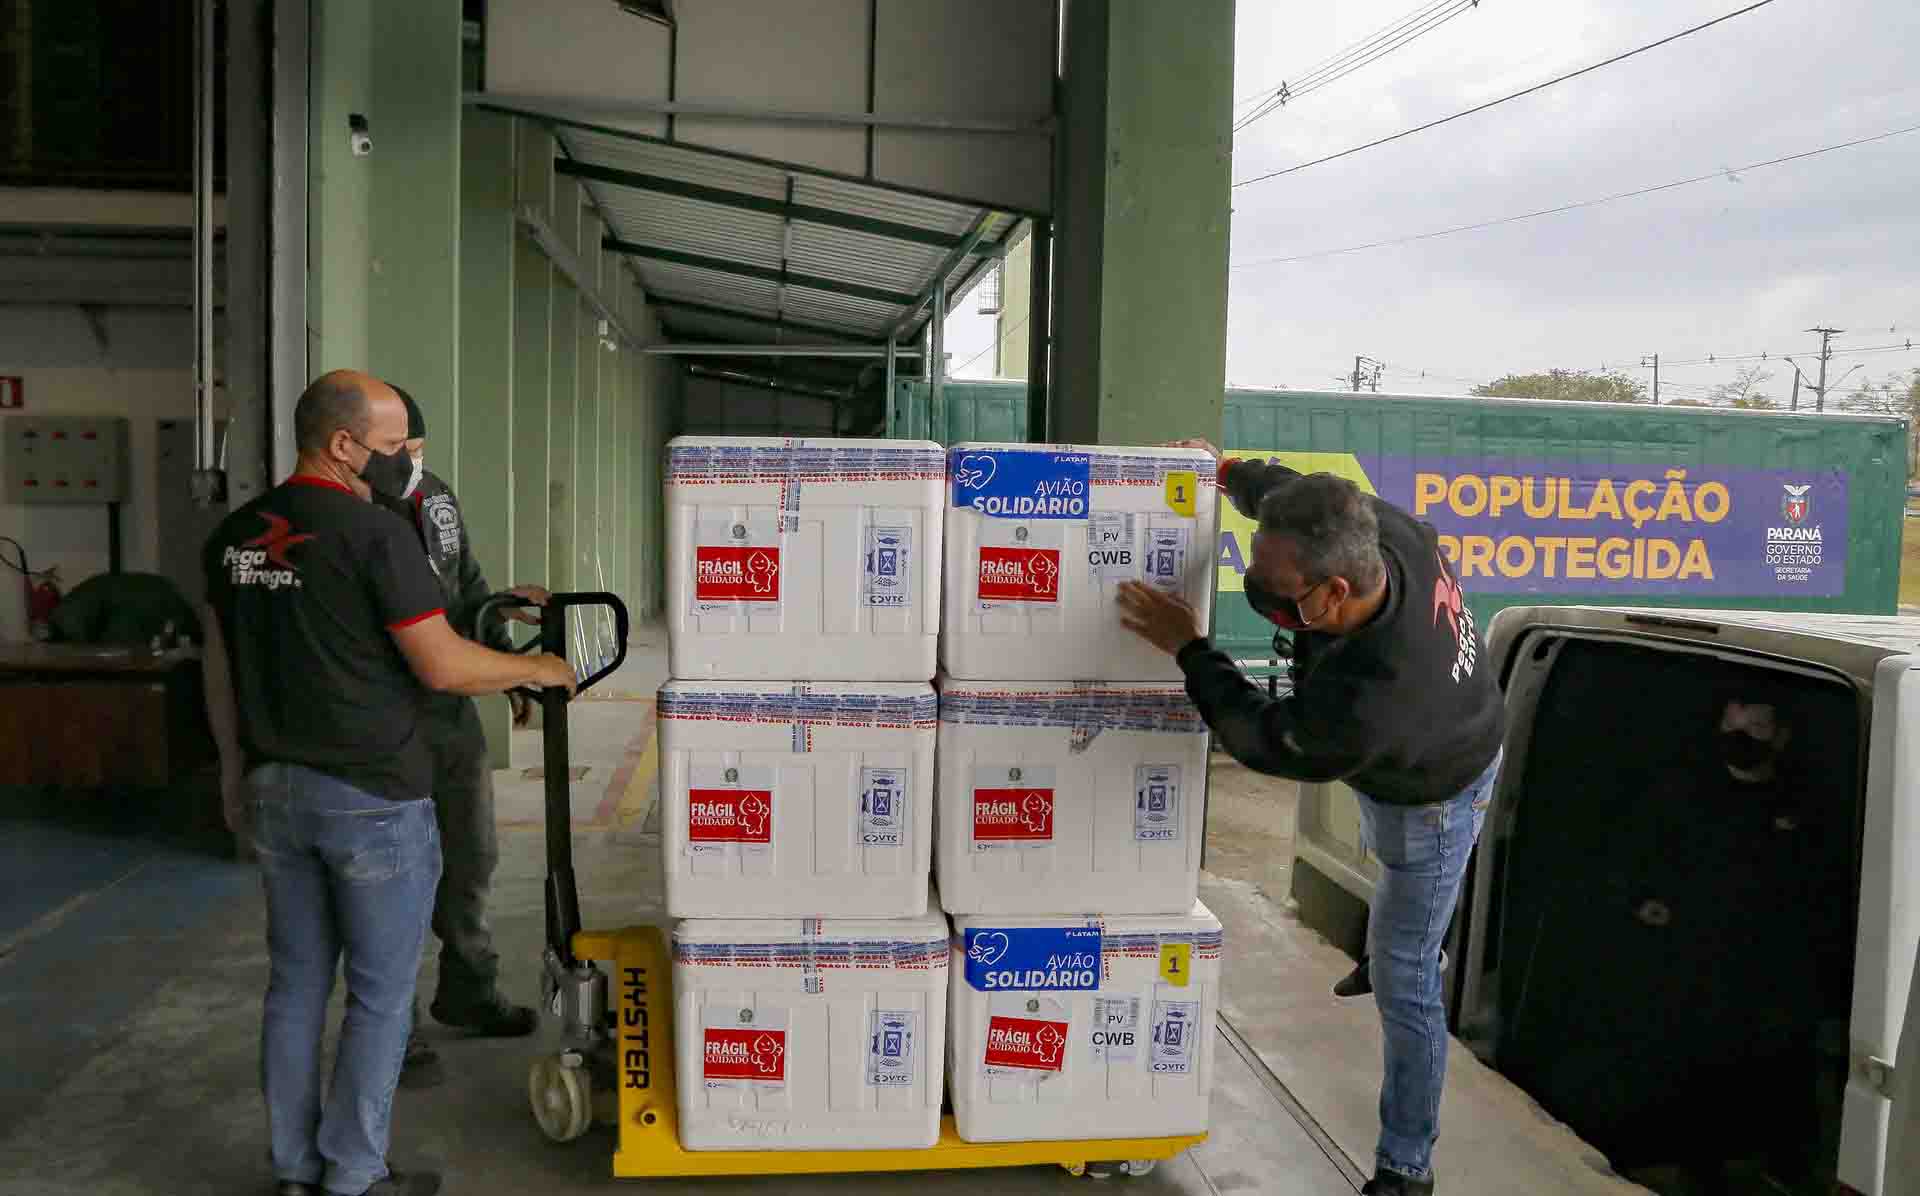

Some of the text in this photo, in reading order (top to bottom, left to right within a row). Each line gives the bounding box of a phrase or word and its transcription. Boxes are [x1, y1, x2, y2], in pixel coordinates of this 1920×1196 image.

[1035, 478, 1084, 495] AVIÃO
[1174, 485, 1187, 503] 1
[974, 493, 1084, 515] SOLIDÁRIO
[1415, 468, 1730, 529] POPULAÇÃO
[1103, 532, 1119, 542] PV
[1766, 525, 1823, 541] PARANÁ
[1766, 544, 1823, 555] GOVERNO
[698, 558, 743, 575] FRÁGIL
[981, 558, 1024, 575] FRÁGIL
[1088, 551, 1132, 566] CWB
[1765, 555, 1822, 565] DO ESTADO
[698, 575, 744, 585] CUIDADO
[980, 575, 1025, 585] CUIDADO
[691, 800, 735, 817] FRÁGIL
[976, 800, 1018, 816] FRÁGIL
[690, 817, 736, 827] CUIDADO
[975, 815, 1019, 825] CUIDADO
[1046, 953, 1095, 969] AVIÃO
[1167, 957, 1181, 973] 1
[985, 967, 1094, 988] SOLIDÁRIO
[1108, 1015, 1124, 1024] PV
[624, 967, 652, 1090] HYSTER
[990, 1027, 1031, 1045] FRÁGIL
[1092, 1031, 1135, 1046] CWB
[705, 1039, 749, 1056] FRÁGIL
[988, 1042, 1031, 1054] CUIDADO
[705, 1055, 750, 1065] CUIDADO
